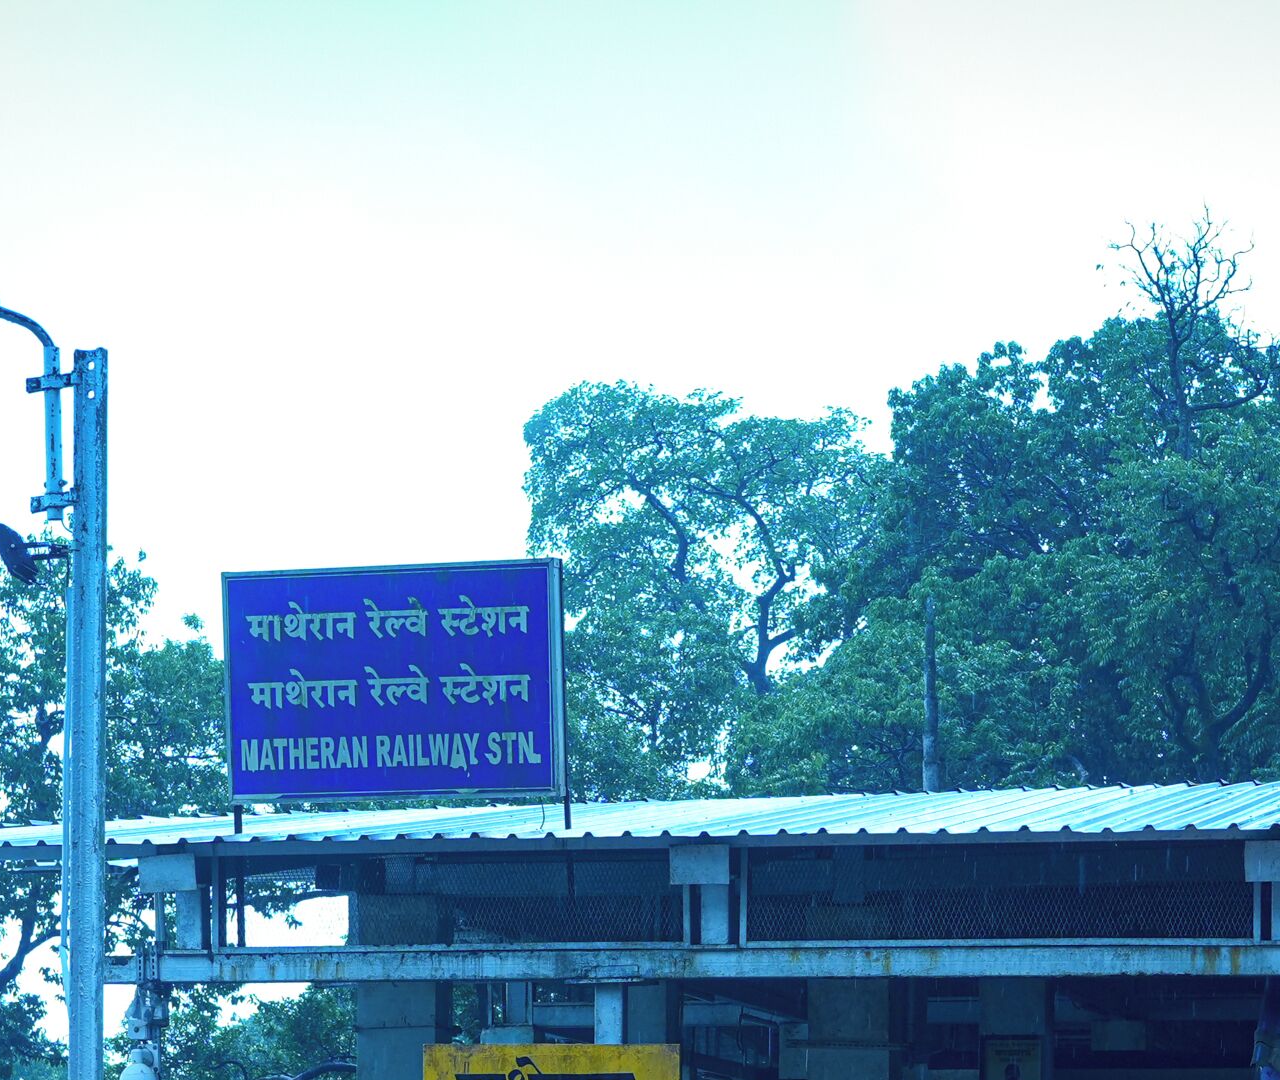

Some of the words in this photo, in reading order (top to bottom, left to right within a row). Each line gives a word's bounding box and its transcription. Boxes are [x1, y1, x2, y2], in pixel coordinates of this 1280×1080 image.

[246, 601, 357, 642] माथेरान
[363, 597, 428, 639] रेल्वे
[438, 595, 530, 638] स्टेशन
[247, 668, 357, 710] माथेरान
[364, 664, 429, 706] रेल्वे
[438, 663, 531, 706] स्टेशन
[241, 736, 368, 772] MATHERAN
[376, 732, 480, 772] RAILWAY
